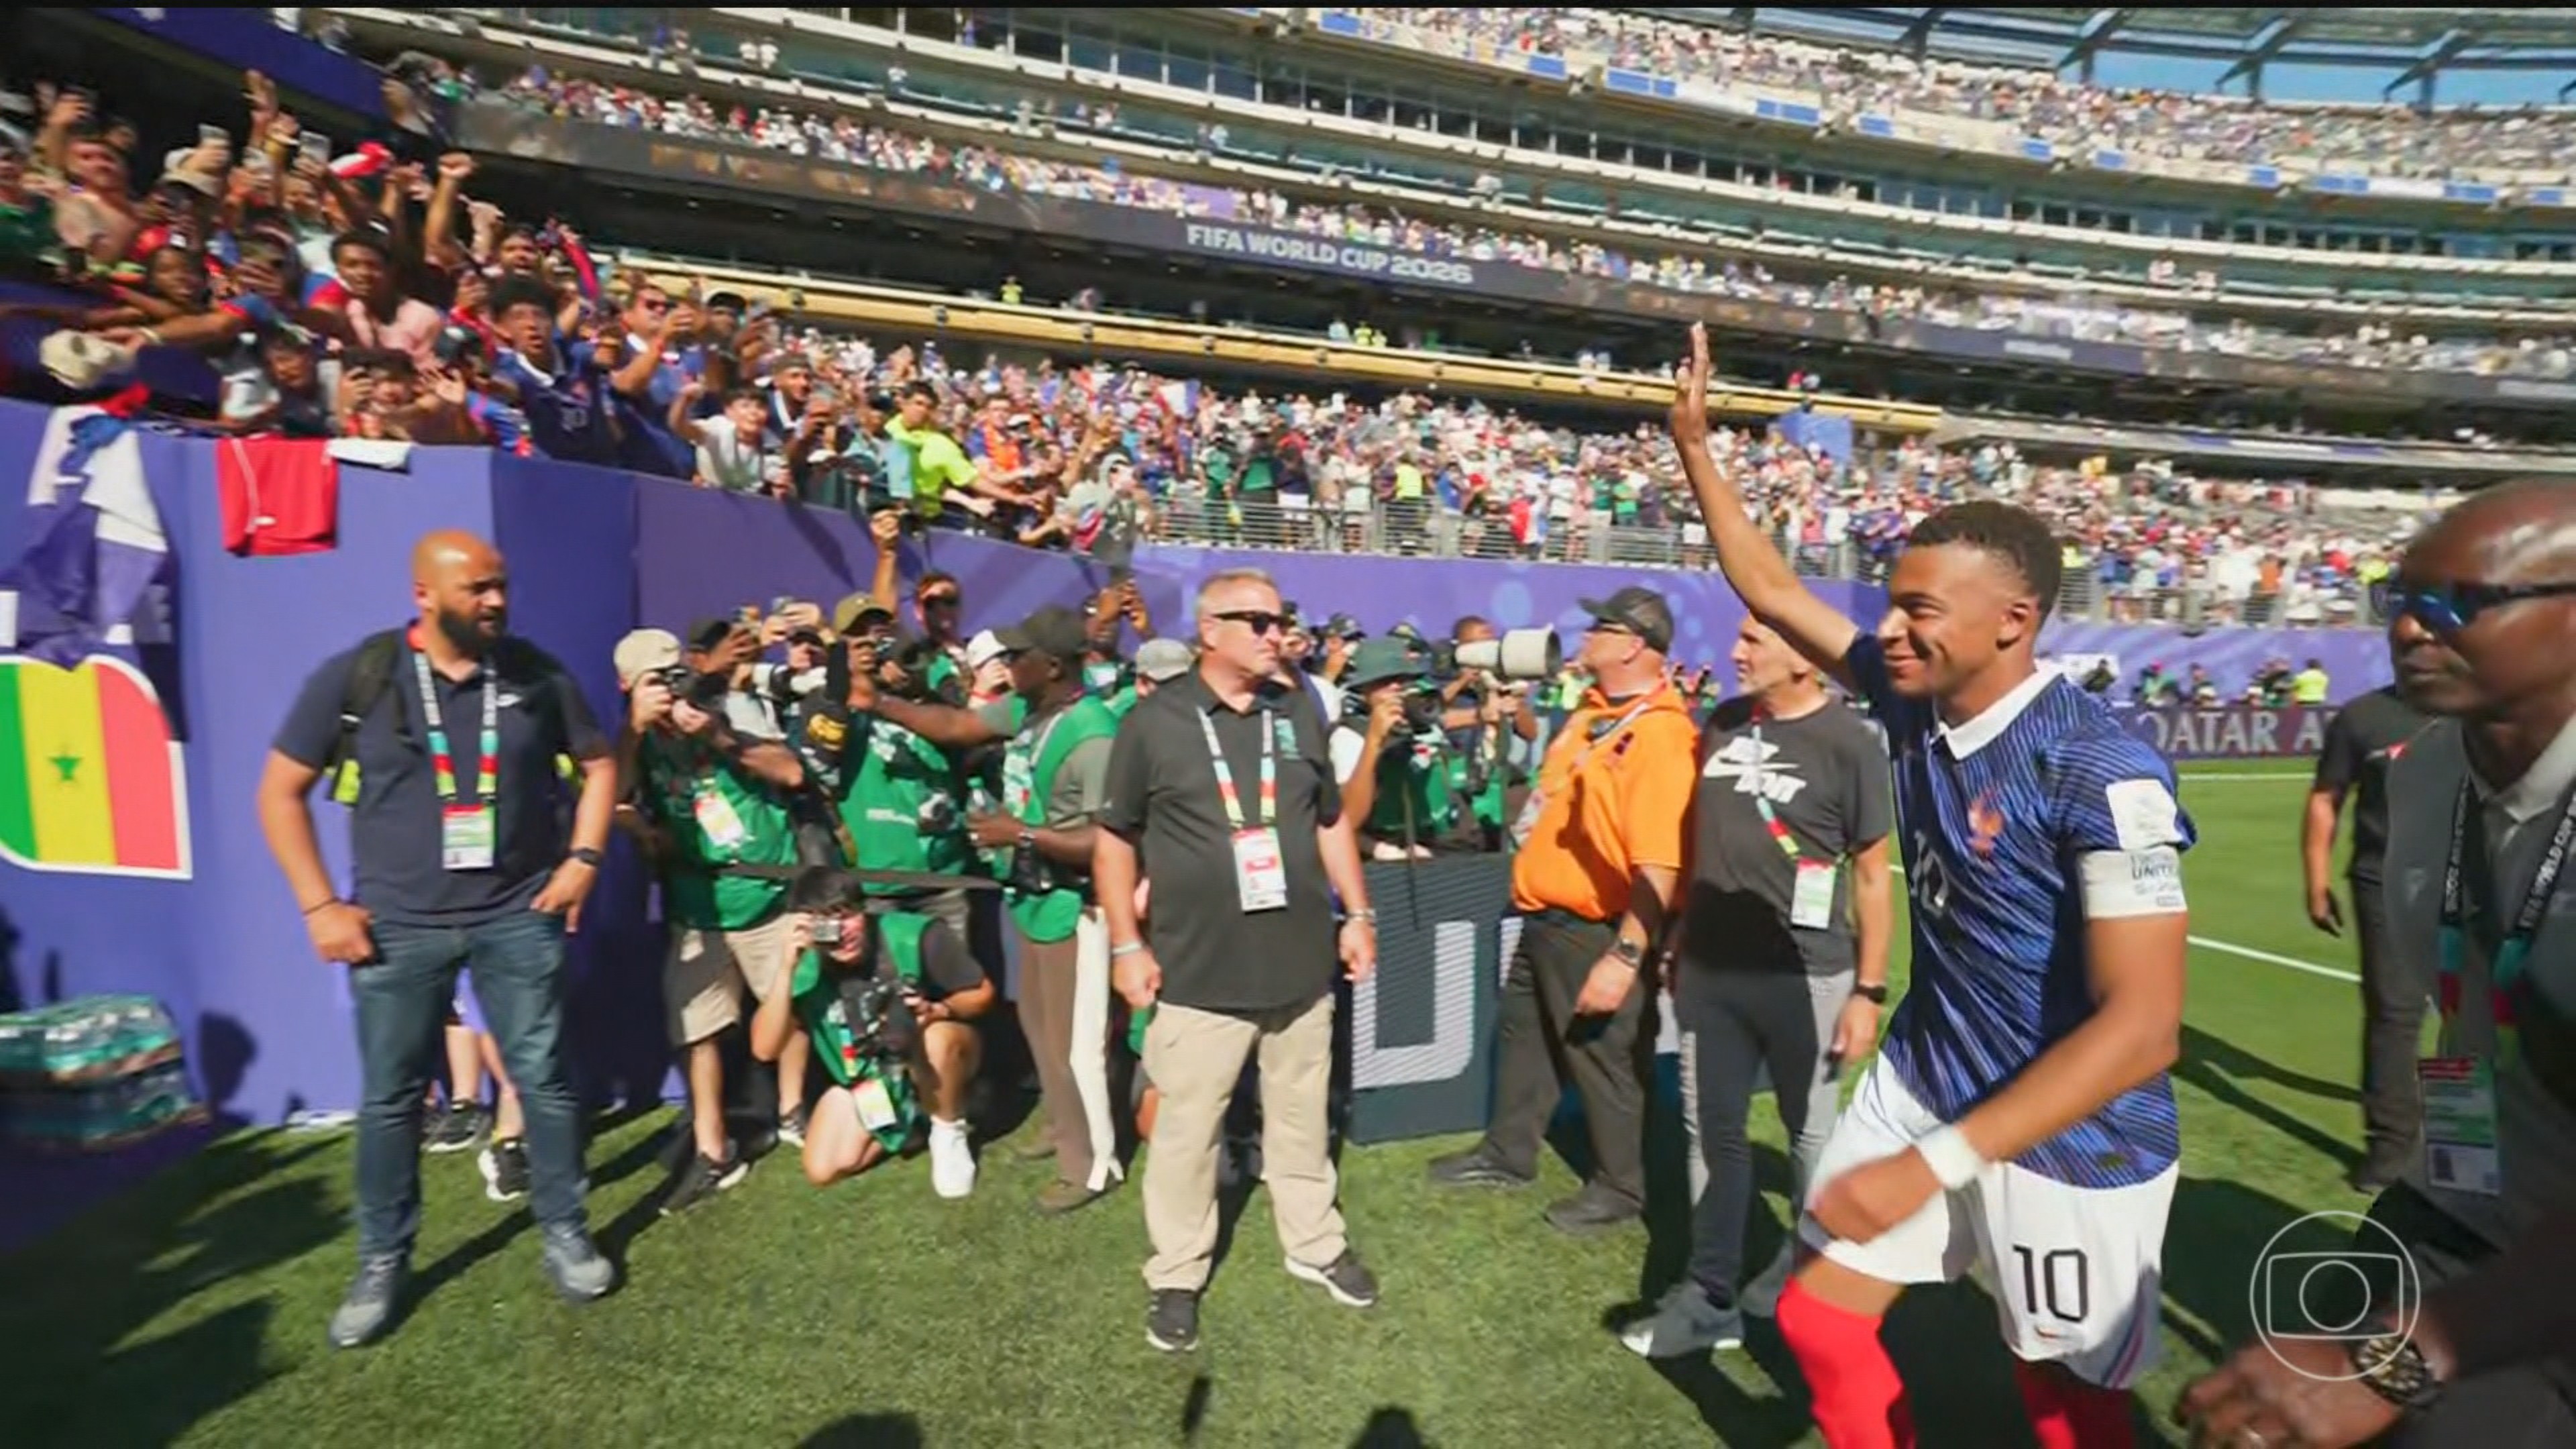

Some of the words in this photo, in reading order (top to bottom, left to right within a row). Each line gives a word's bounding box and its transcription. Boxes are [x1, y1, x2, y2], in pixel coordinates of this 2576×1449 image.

[1186, 225, 1243, 252] FIFA
[1247, 233, 1337, 264] WORLD
[1342, 247, 1388, 272] CUP
[1391, 256, 1474, 284] 2026
[1911, 830, 1949, 919] 10
[2012, 1244, 2088, 1324] 10
